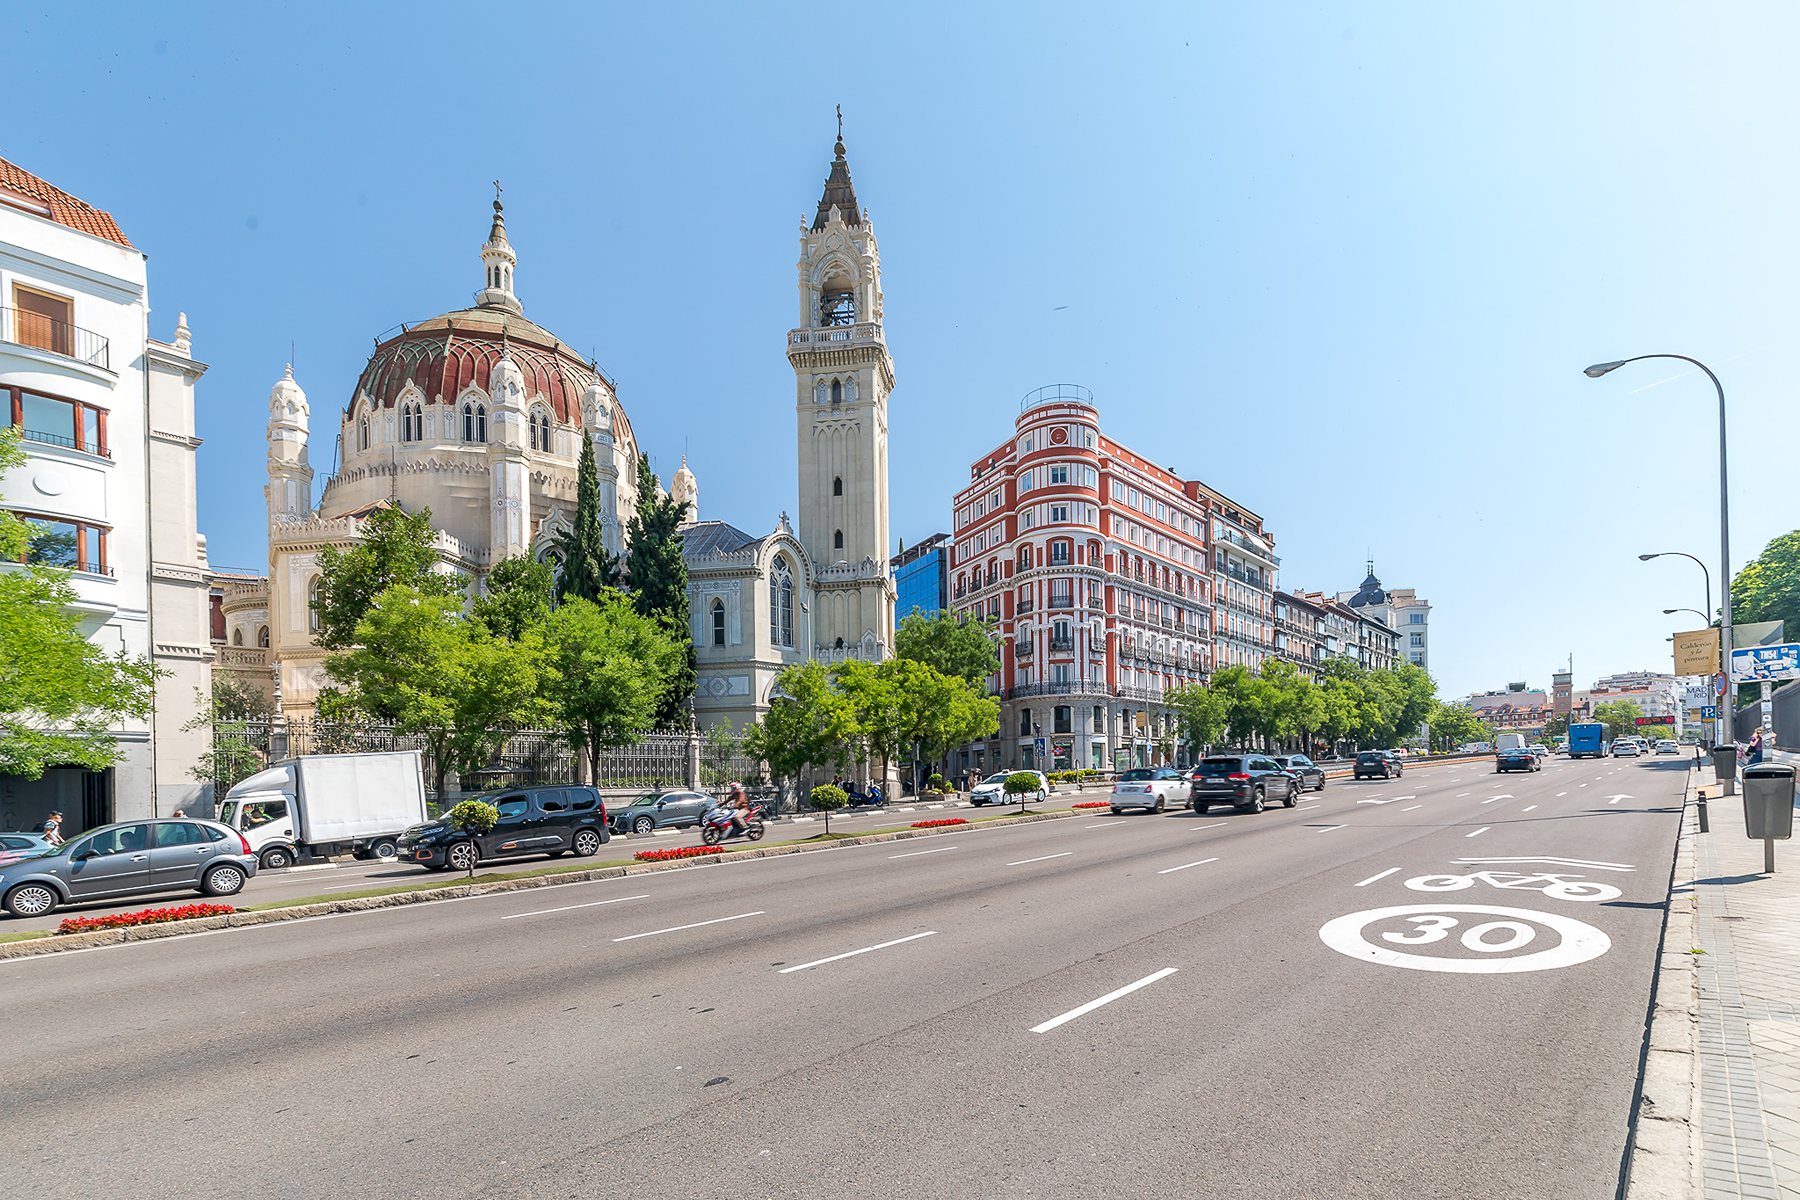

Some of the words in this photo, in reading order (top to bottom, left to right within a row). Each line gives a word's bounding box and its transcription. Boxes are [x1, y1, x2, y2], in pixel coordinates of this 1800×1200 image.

[1680, 641, 1712, 650] Calderón
[1684, 655, 1709, 664] pintura
[1686, 686, 1708, 694] MAD
[1705, 707, 1714, 717] P
[1381, 915, 1536, 952] 30
